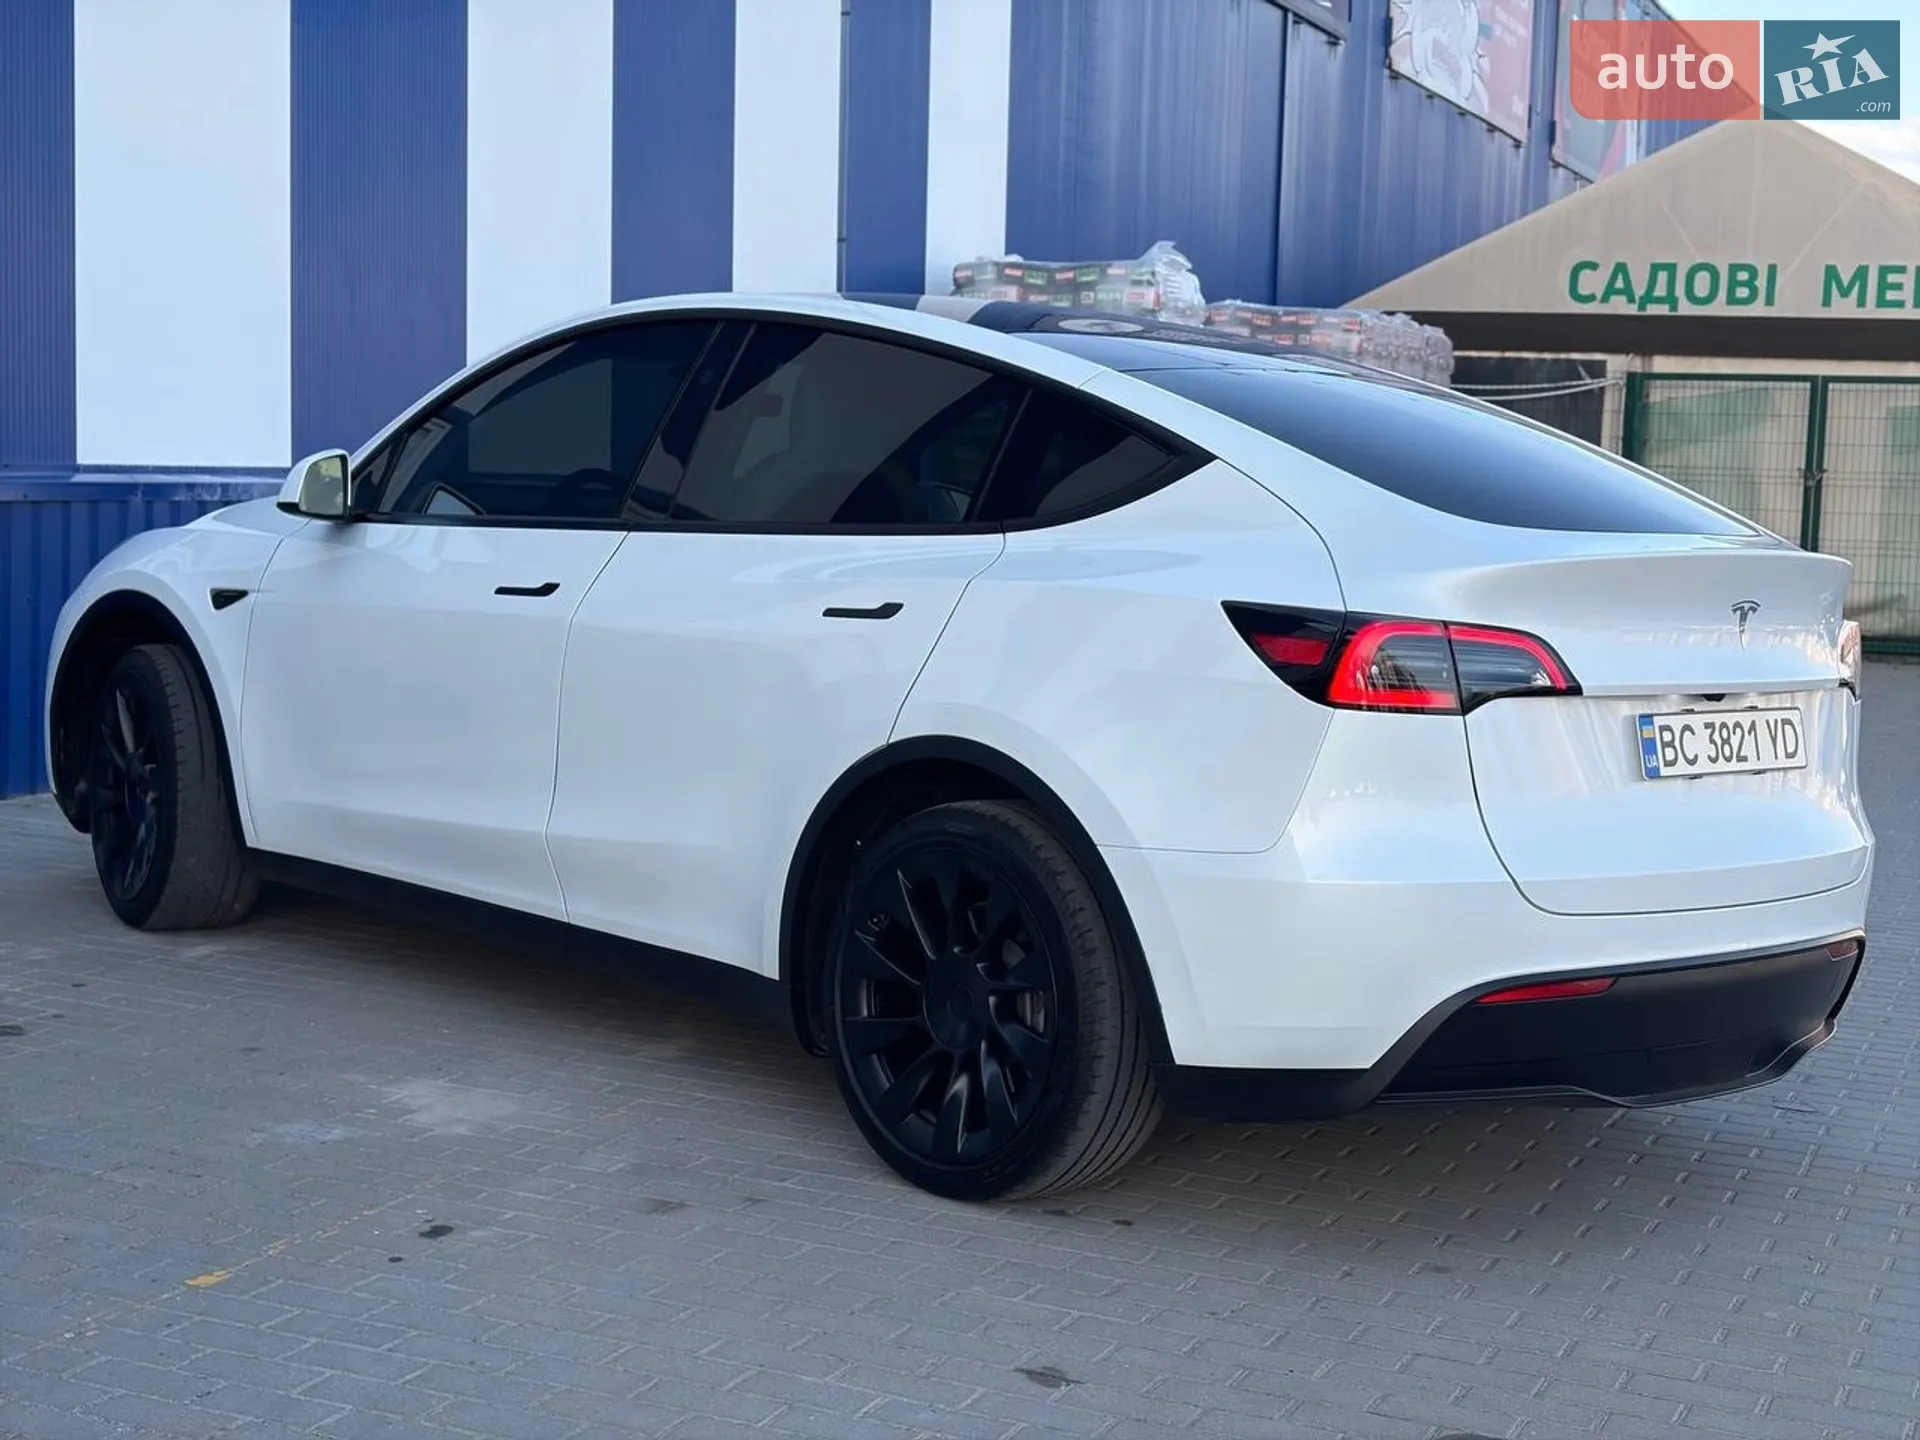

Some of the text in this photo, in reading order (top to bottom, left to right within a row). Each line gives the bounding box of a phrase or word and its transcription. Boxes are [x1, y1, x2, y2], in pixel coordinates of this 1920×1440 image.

[1568, 260, 1779, 313] САДОВІ
[1645, 754, 1659, 768] UA
[1658, 718, 1800, 768] BC 3821 YD
